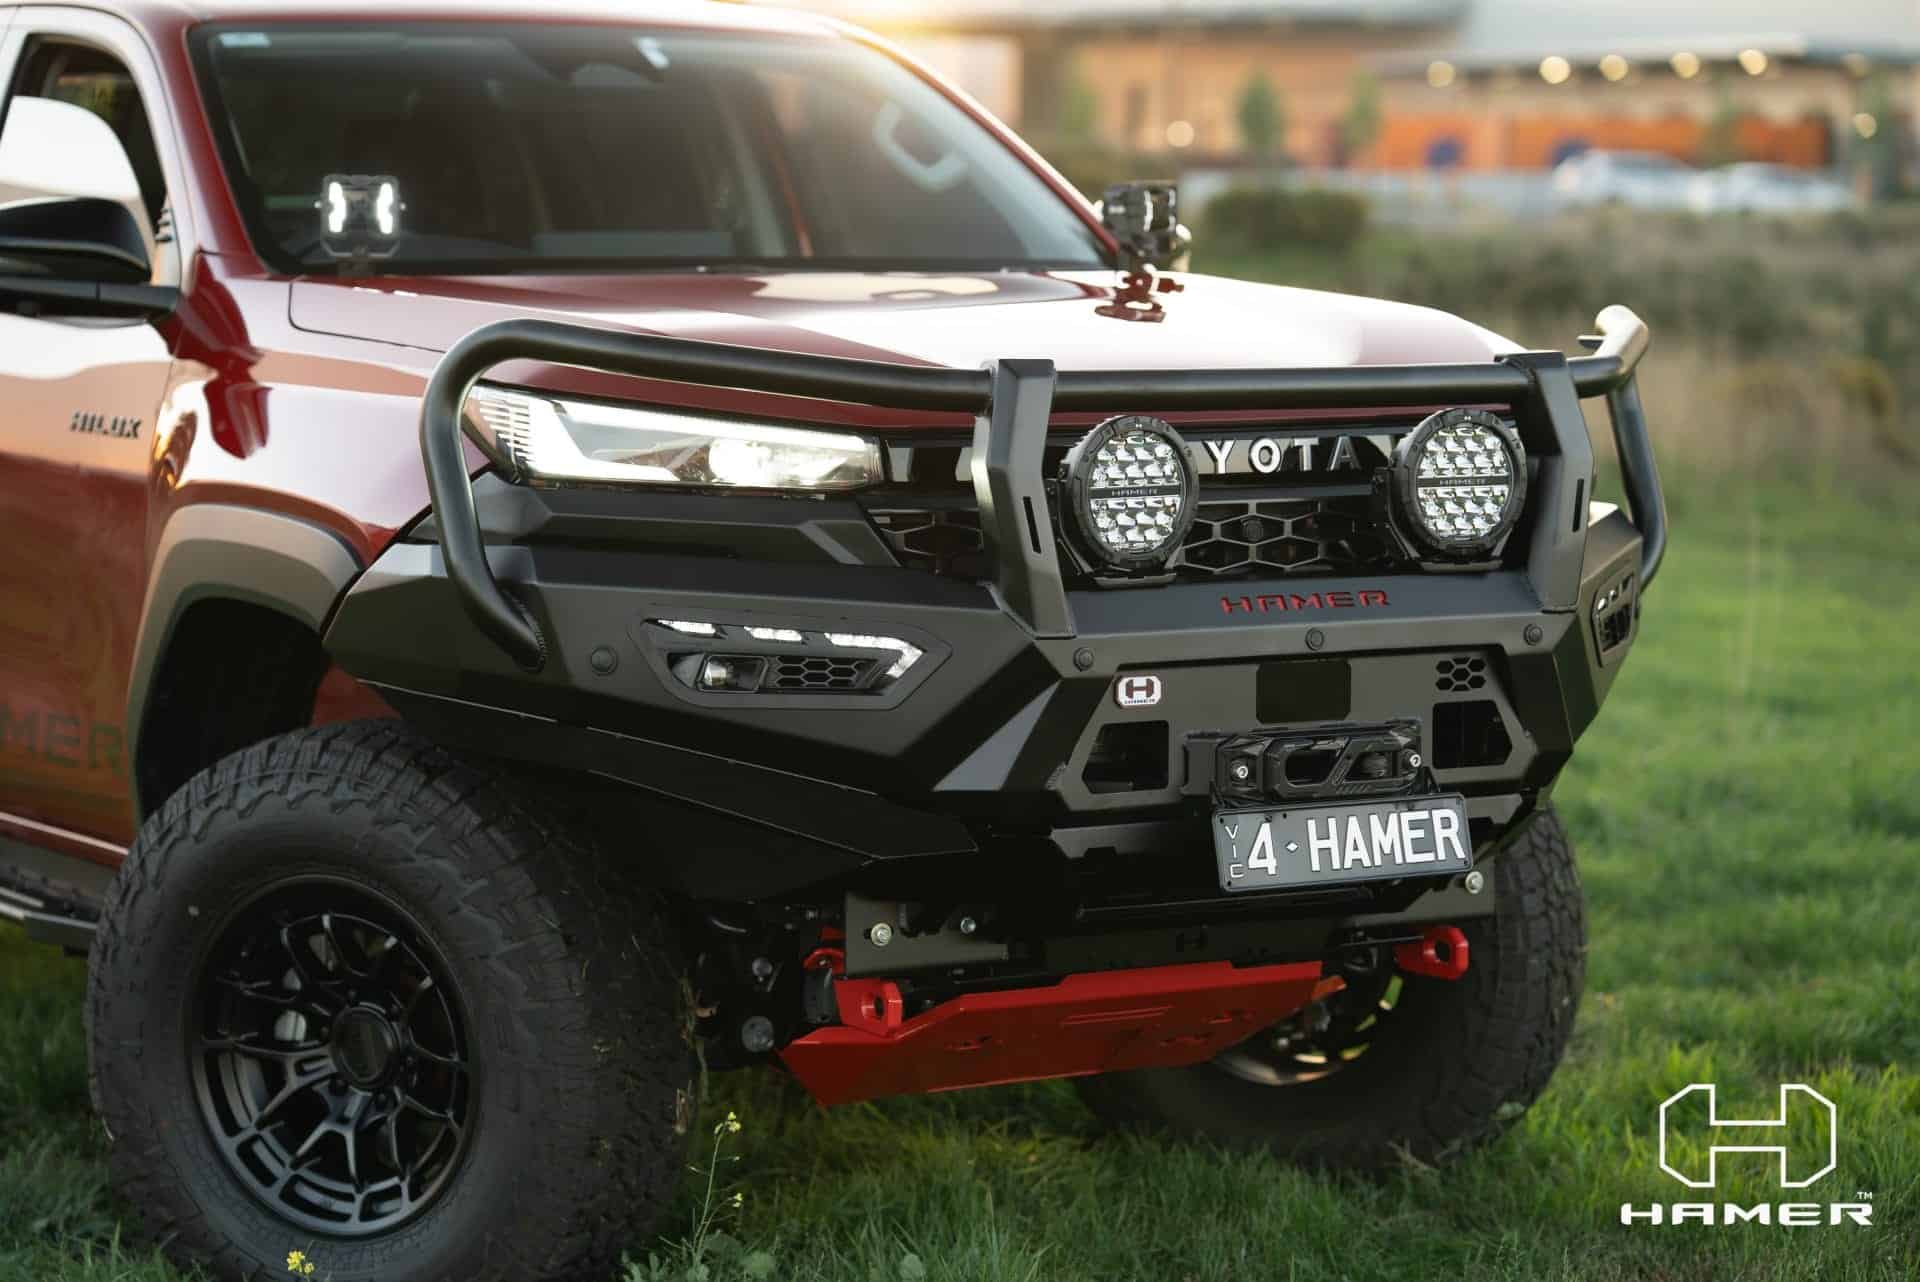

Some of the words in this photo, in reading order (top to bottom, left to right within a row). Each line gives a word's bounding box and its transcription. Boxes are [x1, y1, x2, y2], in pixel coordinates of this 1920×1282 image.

[1206, 436, 1361, 475] YOTA
[1220, 589, 1391, 614] HAMER
[1225, 824, 1245, 879] VIC
[1306, 808, 1467, 872] HAMER
